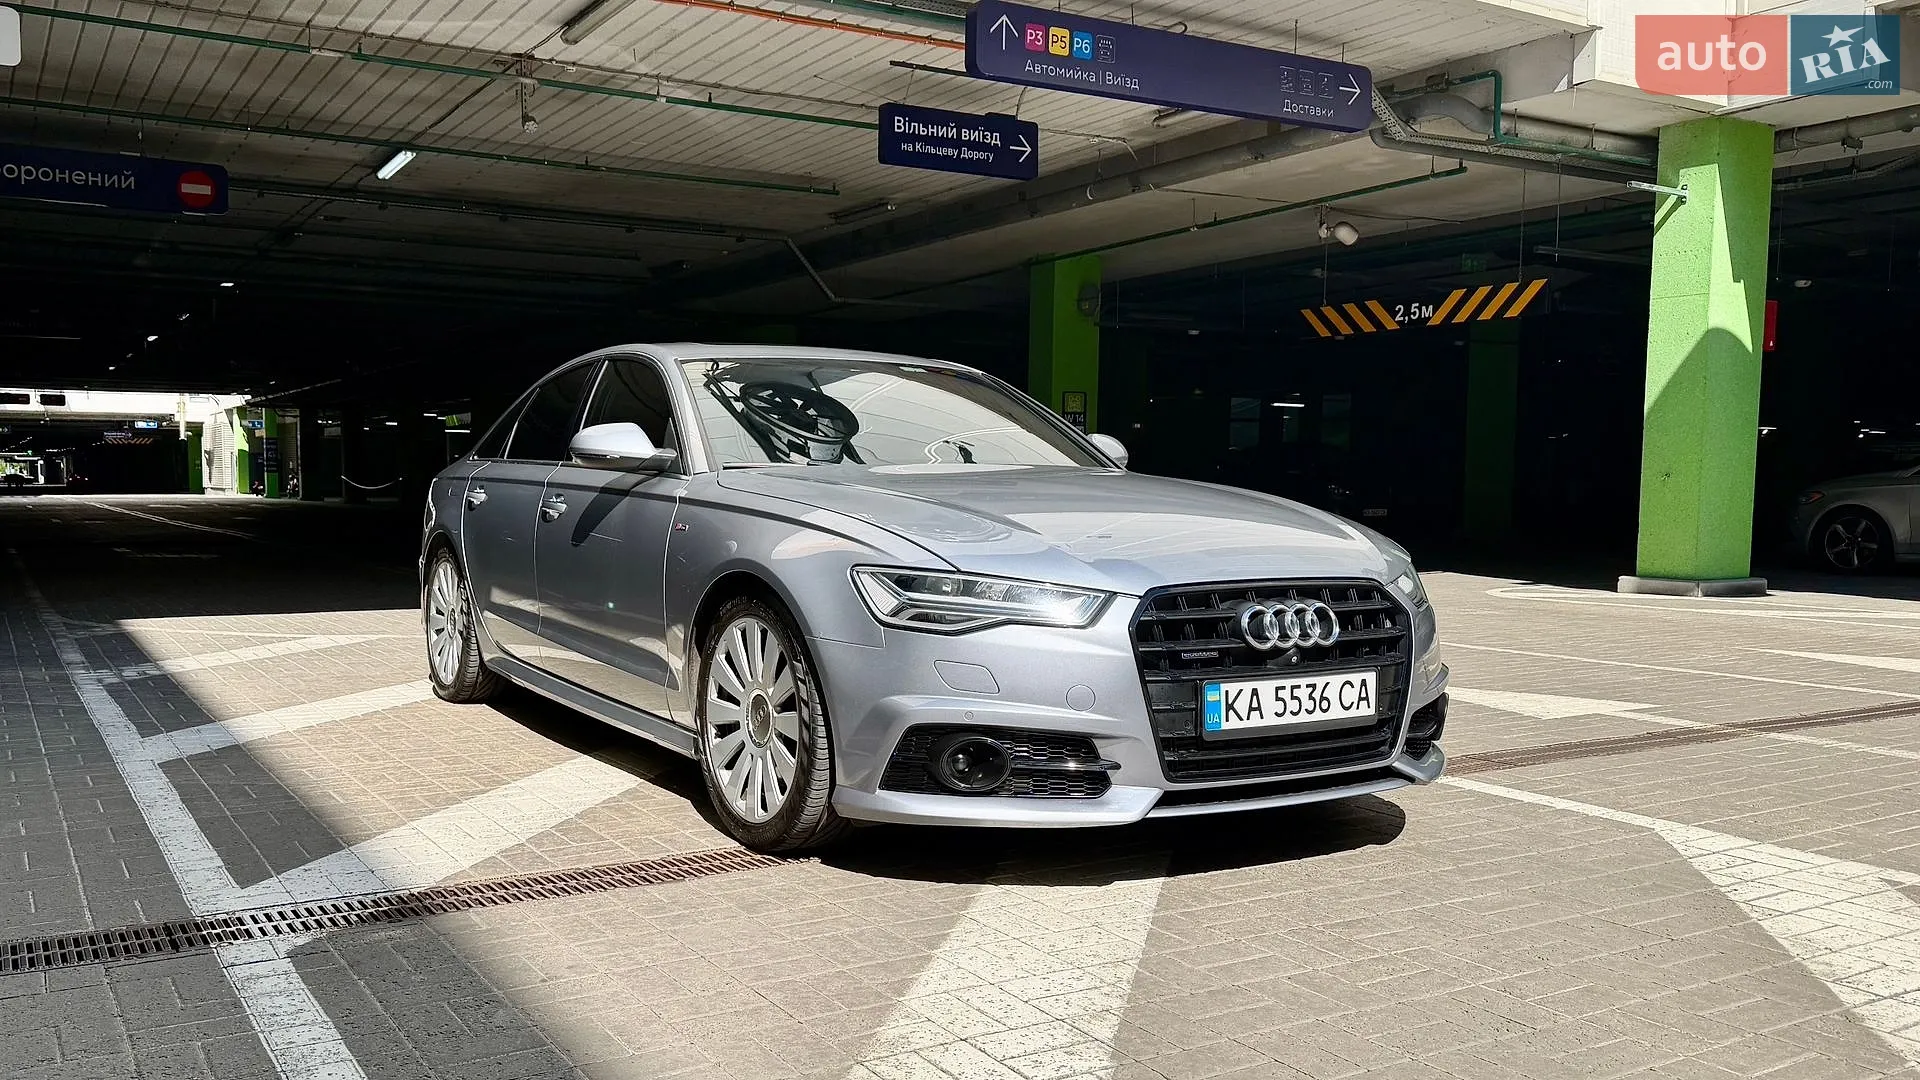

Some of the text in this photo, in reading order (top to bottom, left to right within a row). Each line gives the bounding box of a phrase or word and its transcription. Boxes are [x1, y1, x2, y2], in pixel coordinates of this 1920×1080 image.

[1027, 29, 1091, 54] P3 P5 P6
[1024, 58, 1140, 91] Автомийка Виїзд
[1283, 99, 1335, 118] Доставки
[894, 115, 1001, 147] Вільний виїзд
[901, 141, 995, 163] на Кільцеву Дорогу
[0, 163, 136, 190] оронений
[1273, 681, 1333, 718] 5536
[1207, 713, 1220, 724] UA
